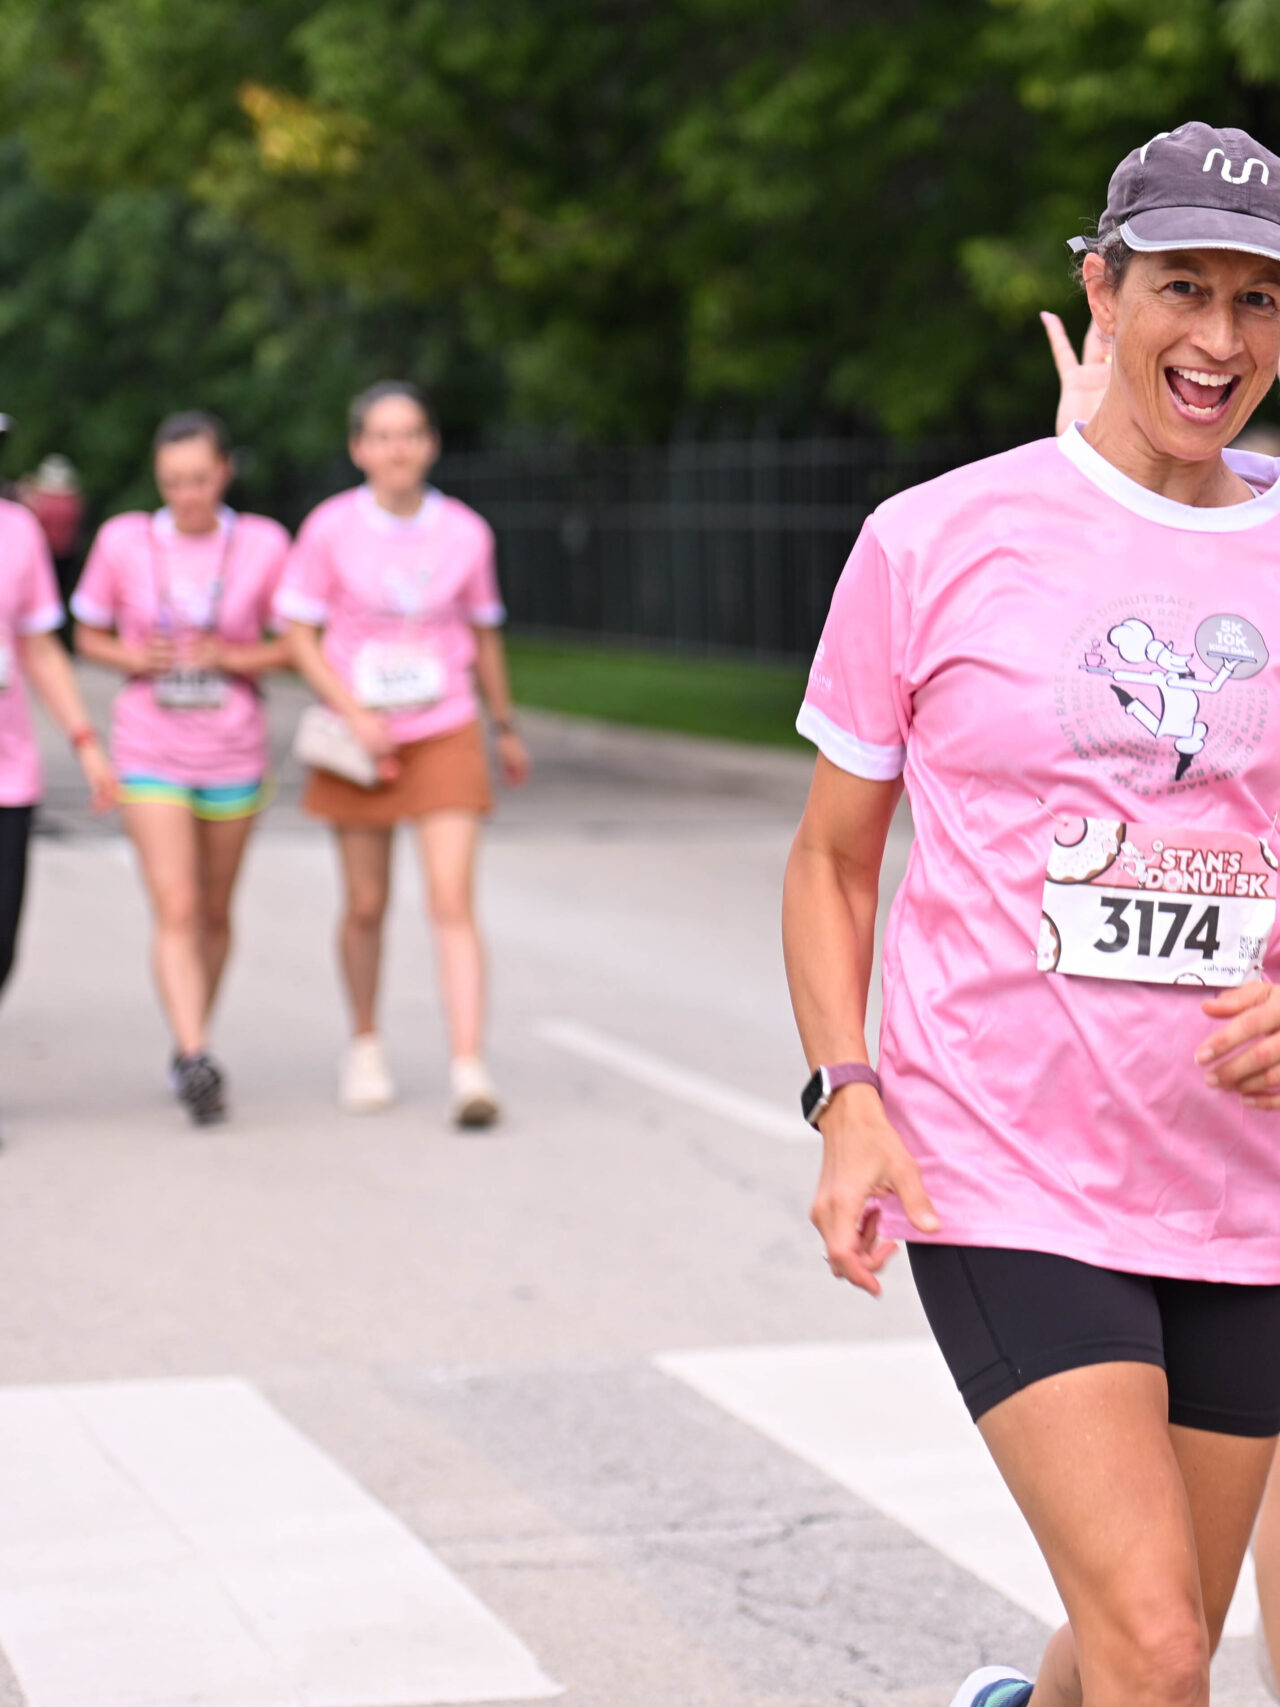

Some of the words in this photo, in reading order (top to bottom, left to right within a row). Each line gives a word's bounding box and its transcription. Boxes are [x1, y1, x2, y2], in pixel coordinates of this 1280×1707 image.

[1215, 631, 1249, 649] 10K
[1221, 619, 1243, 635] 5K
[1160, 848, 1242, 874] STAN'S
[1145, 869, 1231, 895] DONUT
[1233, 873, 1268, 897] 5K
[1093, 896, 1221, 960] 3174
